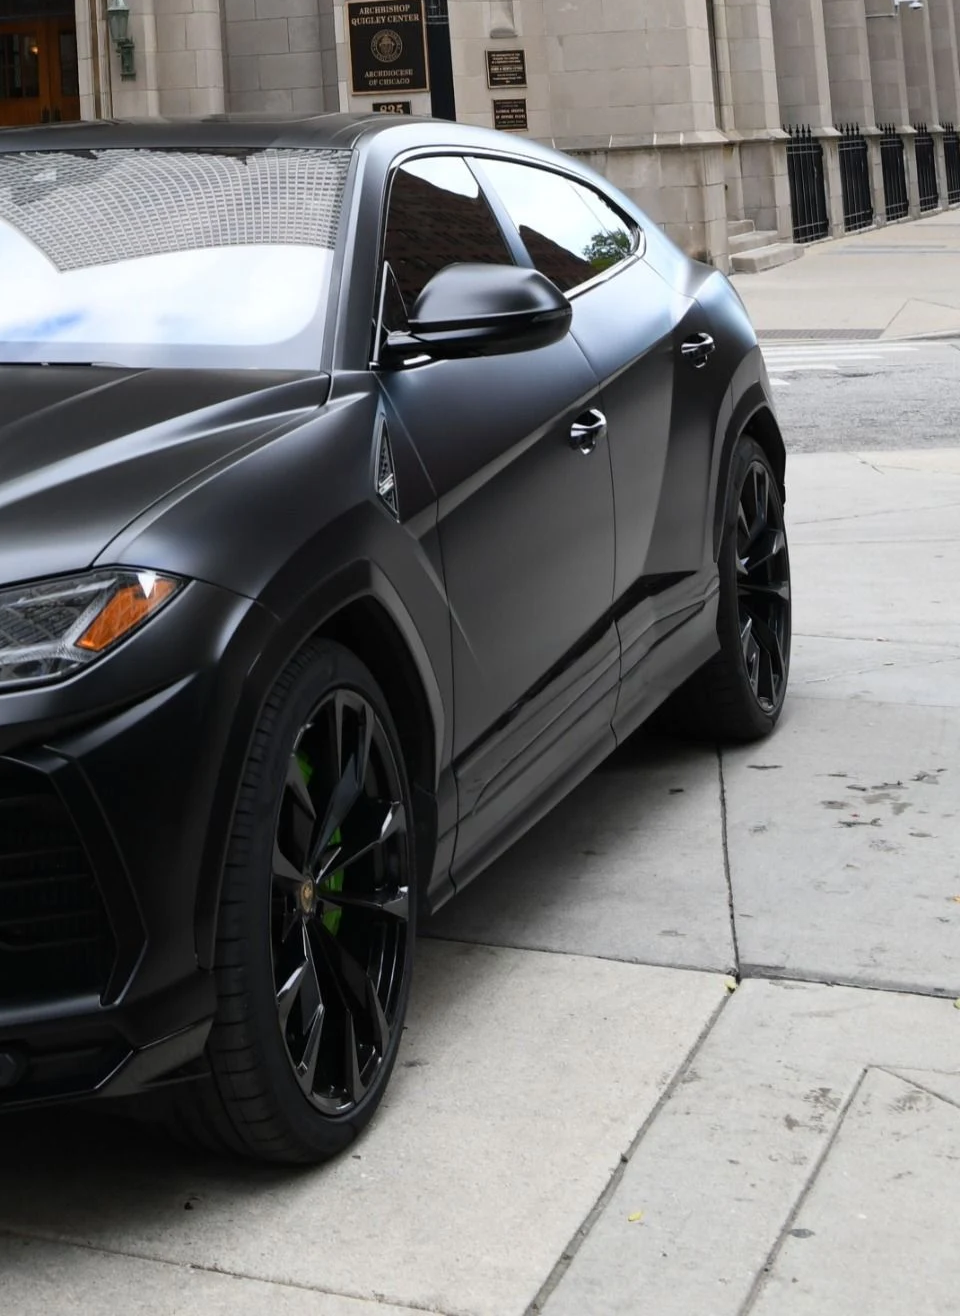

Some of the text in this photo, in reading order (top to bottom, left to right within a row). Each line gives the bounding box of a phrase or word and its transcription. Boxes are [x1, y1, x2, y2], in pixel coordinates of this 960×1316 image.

[359, 4, 410, 15] ARCHBISHOP
[351, 13, 420, 26] QUIGLEY CENTER
[364, 68, 413, 78] ARCHDIOCESE
[368, 77, 410, 86] OF CHICAGO
